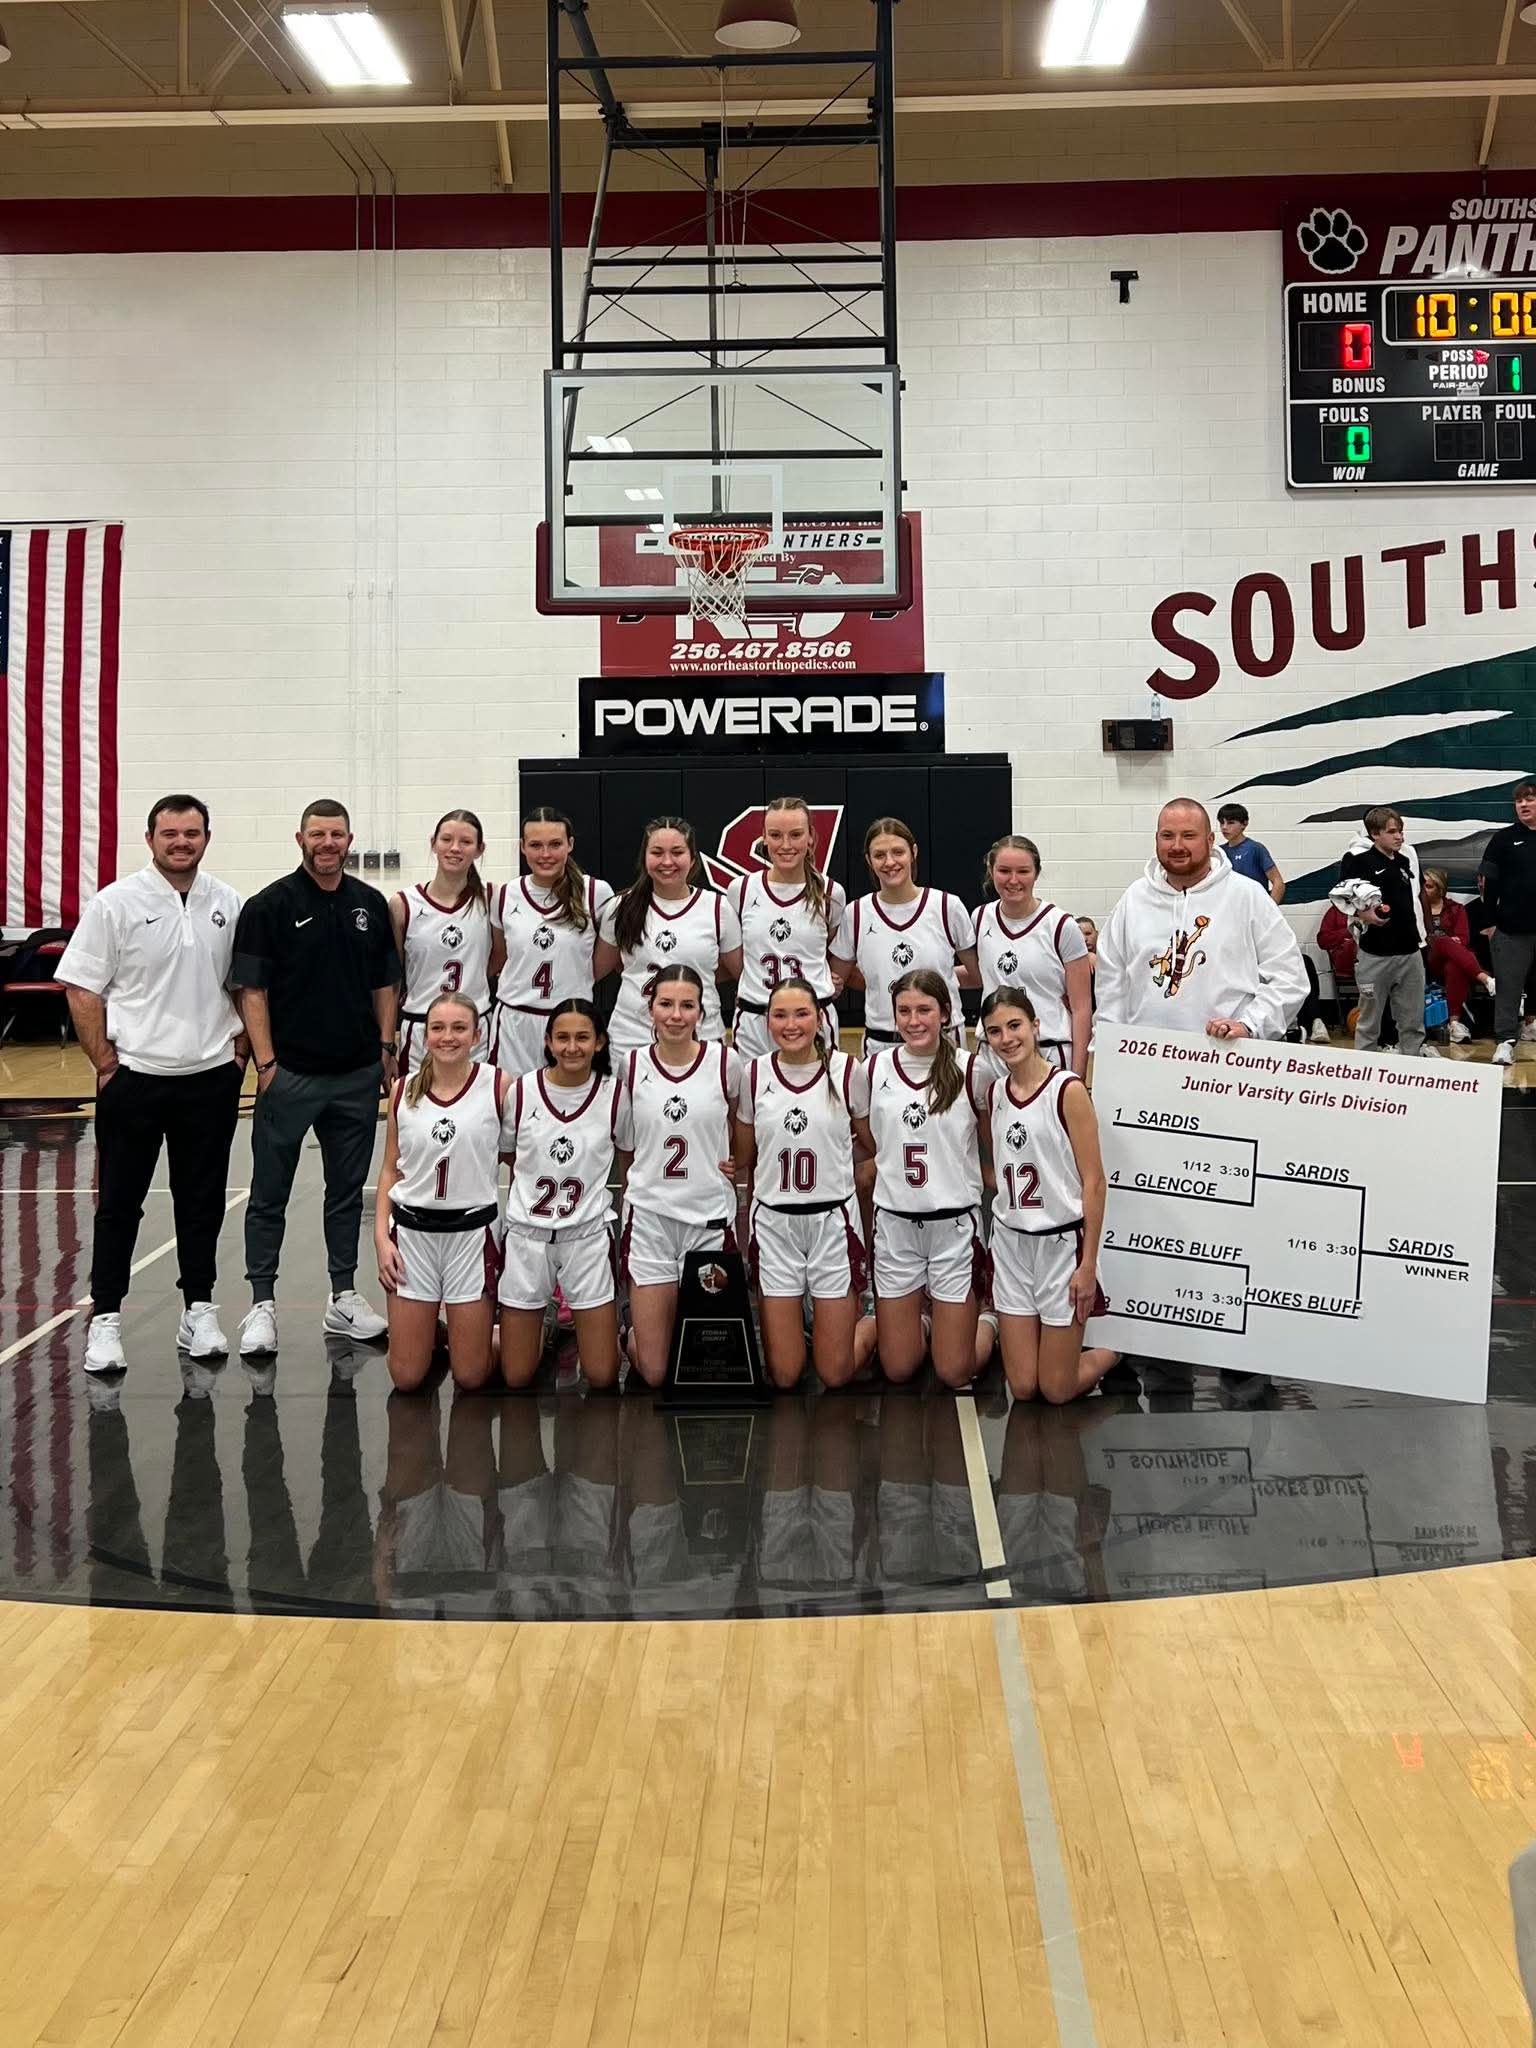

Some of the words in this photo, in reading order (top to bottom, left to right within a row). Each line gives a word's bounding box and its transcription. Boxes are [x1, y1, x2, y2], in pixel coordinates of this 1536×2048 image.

[1303, 292, 1367, 313] HOME
[1344, 323, 1372, 368] 0
[1442, 349, 1474, 362] POSS
[1332, 377, 1385, 393] BONUS
[1429, 364, 1488, 380] PERIOD
[1511, 356, 1521, 391] 1
[1319, 407, 1369, 423] FOULS
[1422, 405, 1482, 421] PLAYER
[1495, 404, 1536, 419] FOUL
[1347, 426, 1370, 461] 0
[1332, 466, 1366, 480] WON
[1458, 463, 1499, 477] GAME
[1146, 529, 1536, 699] SOUTH
[670, 642, 852, 660] 256.467.8566
[669, 659, 857, 673] www.northeastorthopedics.com
[440, 959, 464, 993] 3
[532, 960, 554, 999] 4
[1118, 1039, 1157, 1057] 2026
[1162, 1044, 1220, 1064] Etowah
[1225, 1051, 1282, 1074] County
[1286, 1058, 1373, 1082] Basketball
[1378, 1069, 1479, 1093] Tournament
[1181, 1075, 1233, 1095] Junior
[1238, 1082, 1294, 1105] Varsity
[1299, 1089, 1336, 1107] Girls
[1341, 1095, 1408, 1115] Division
[1115, 1108, 1123, 1121] 1
[1137, 1110, 1200, 1131] SARDIS
[663, 1135, 688, 1180] 2
[778, 1147, 817, 1193] 10
[903, 1143, 928, 1188] 5
[1182, 1160, 1211, 1173] 1/12
[1219, 1165, 1250, 1178] 3:30
[434, 1156, 450, 1200] 1
[1110, 1170, 1121, 1183] 4
[1134, 1173, 1218, 1196] GLENCOE
[1284, 1161, 1350, 1183] SARDIS
[529, 1176, 585, 1218] 23
[1002, 1162, 1044, 1209] 12
[1105, 1230, 1115, 1243] 2
[1128, 1233, 1185, 1253] HOKES
[1189, 1242, 1243, 1261] BLUFF
[1287, 1238, 1317, 1251] 1/16
[1326, 1243, 1357, 1256] 3:30
[1387, 1238, 1454, 1259] SARDIS
[1405, 1264, 1469, 1282] WINNER
[1175, 1288, 1204, 1301] 1/13
[1212, 1293, 1243, 1306] 3:30
[1244, 1287, 1303, 1308] HOKES
[1307, 1295, 1363, 1315] BLUFF
[1125, 1298, 1226, 1327] SOUTHSIDE
